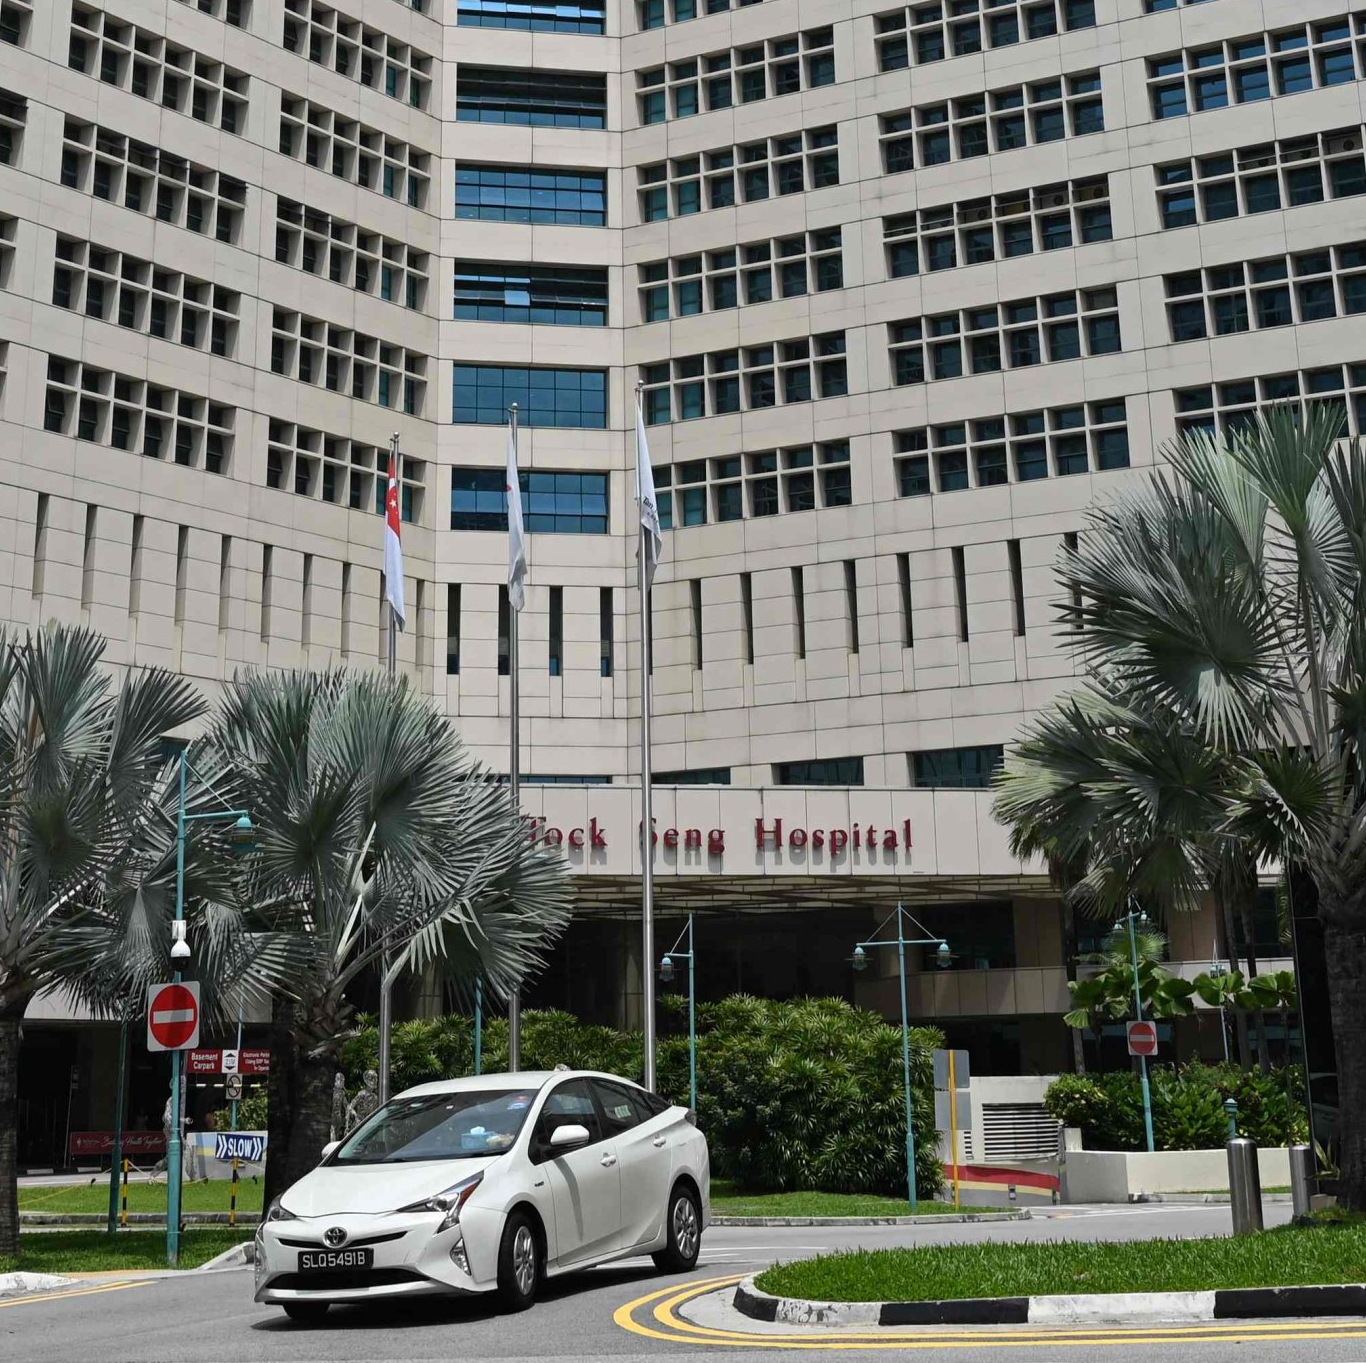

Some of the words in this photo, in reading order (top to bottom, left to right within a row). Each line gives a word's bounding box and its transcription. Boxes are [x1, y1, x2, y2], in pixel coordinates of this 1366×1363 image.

[643, 495, 654, 509] Tan
[755, 818, 913, 855] Hospital
[191, 1052, 218, 1061] Basement
[193, 1061, 215, 1071] Carpark
[227, 1138, 253, 1157] SLOW
[302, 1251, 366, 1269] SLQ5491B
